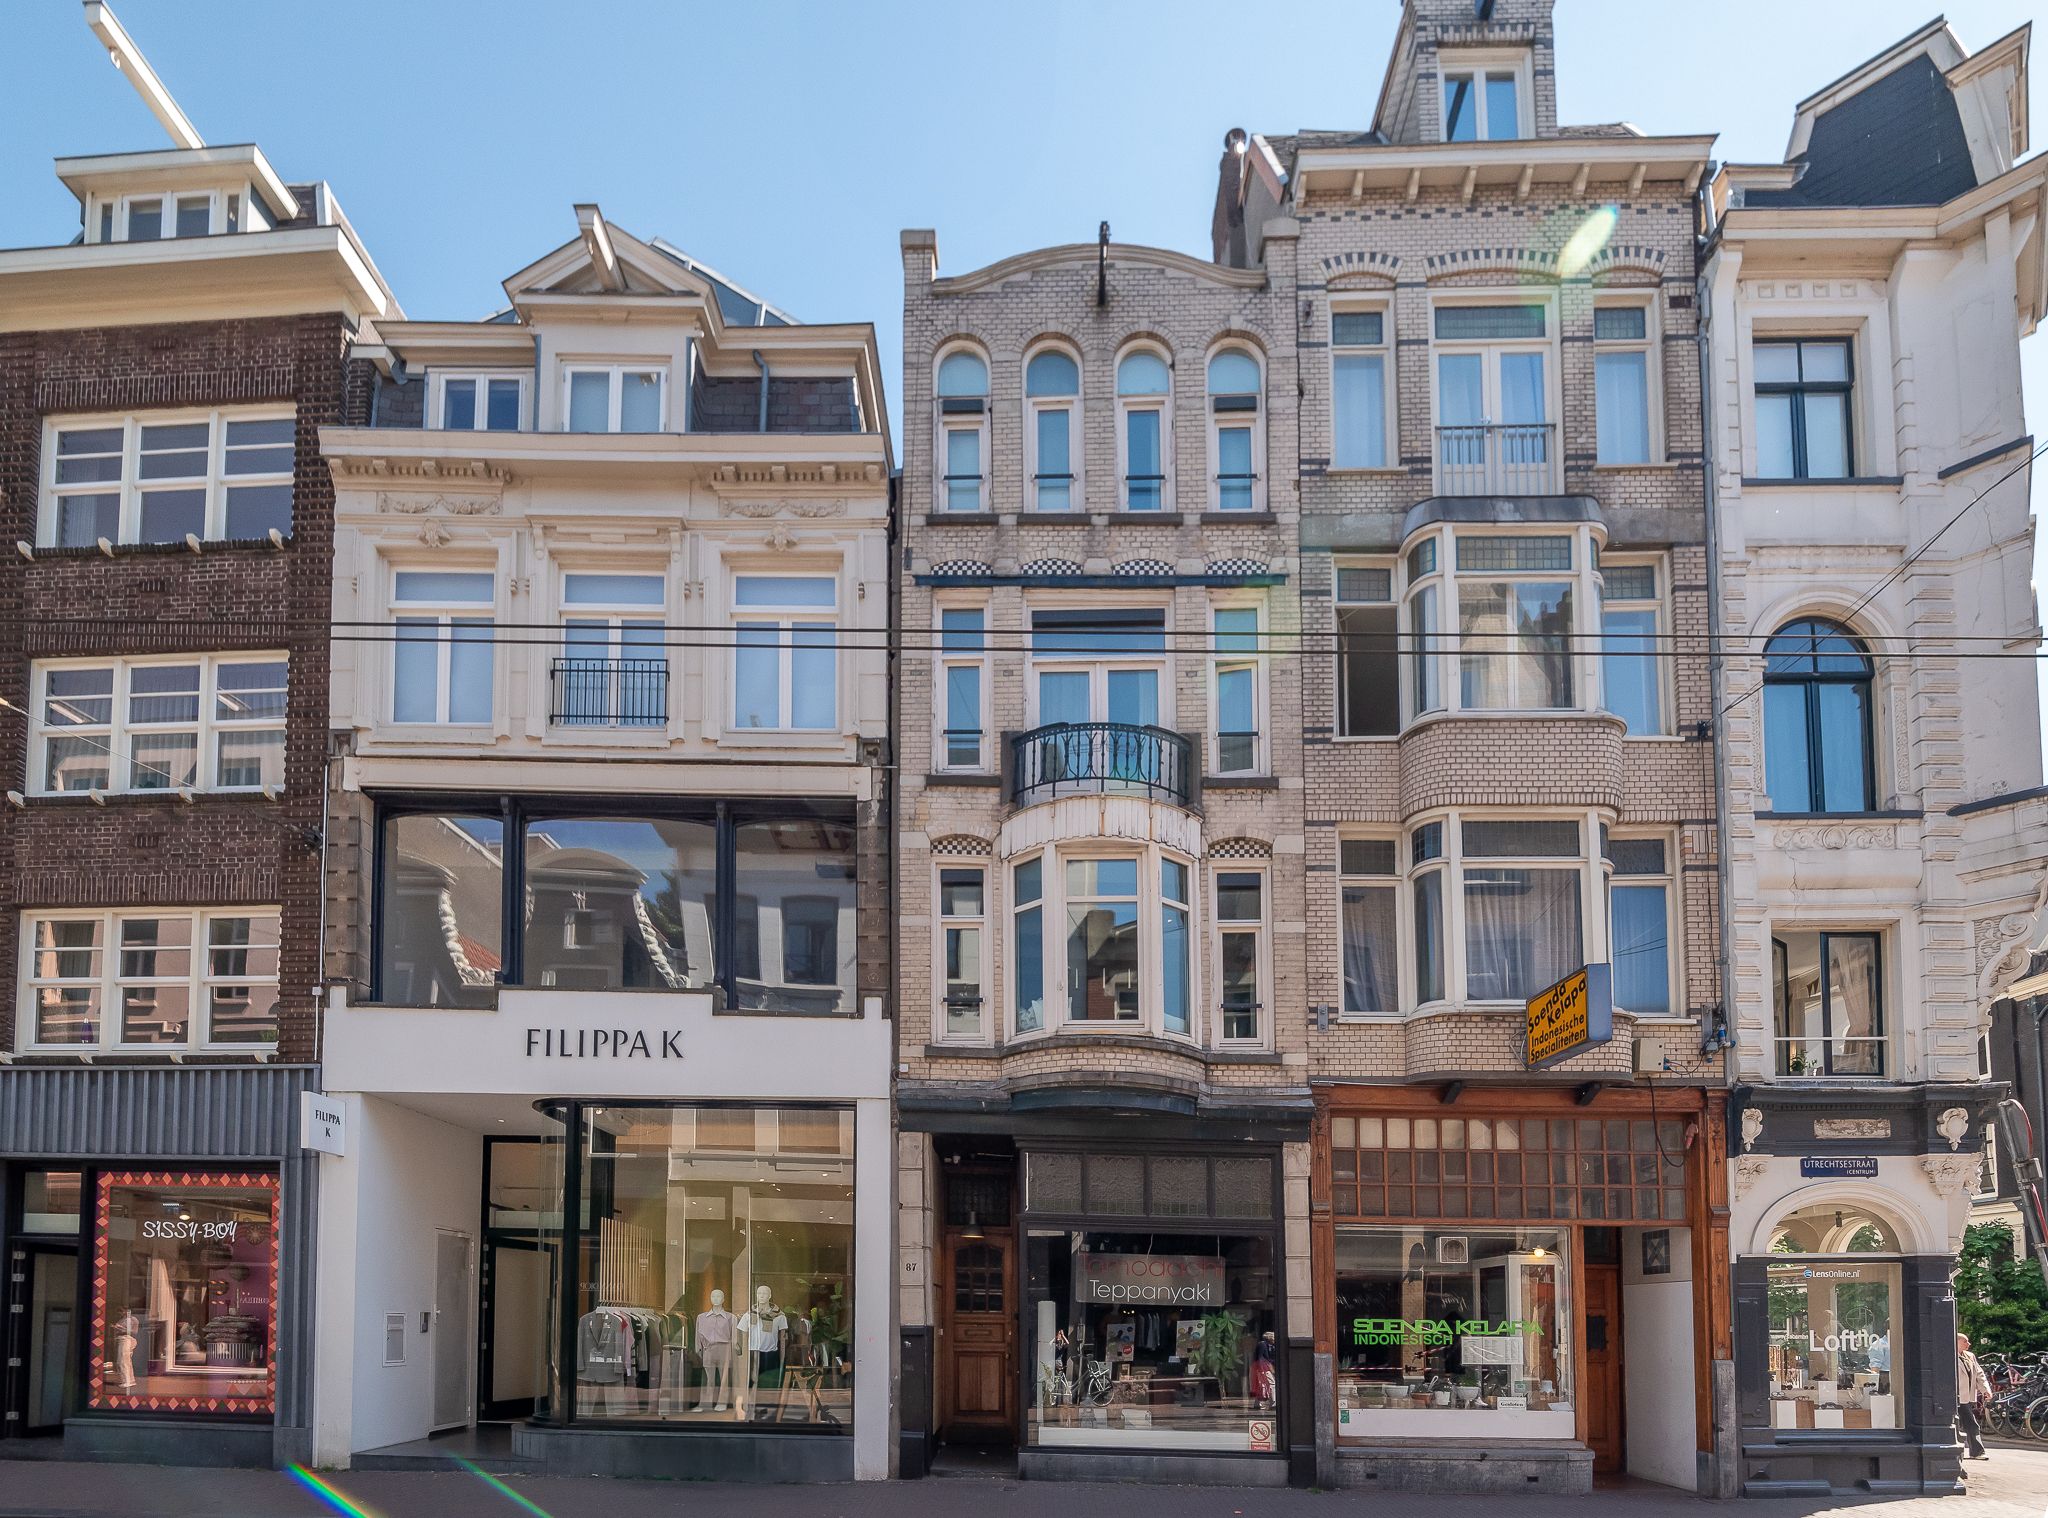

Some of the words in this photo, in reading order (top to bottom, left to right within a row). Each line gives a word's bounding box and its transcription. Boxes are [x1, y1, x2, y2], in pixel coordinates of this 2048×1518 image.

[1528, 983, 1567, 1034] Soenda
[1547, 978, 1586, 1029] Kelapa
[1531, 1014, 1584, 1048] Indonesische
[526, 1028, 651, 1058] FILIPPA
[662, 1030, 684, 1059] K
[1530, 1029, 1585, 1062] Specialiteiten
[315, 1109, 341, 1126] FILIPPA
[325, 1126, 331, 1138] K
[1804, 1160, 1875, 1169] UTRECHTSESTRAAT
[142, 1220, 238, 1243] SISSY-BOY
[905, 1262, 918, 1272] 87
[1812, 1270, 1861, 1278] LensOnline.nl
[1089, 1279, 1211, 1304] Teppanyaki
[1353, 1318, 1454, 1335] SOENDA
[1354, 1333, 1453, 1346] INDONESISCH
[1809, 1329, 1859, 1352] Loft
